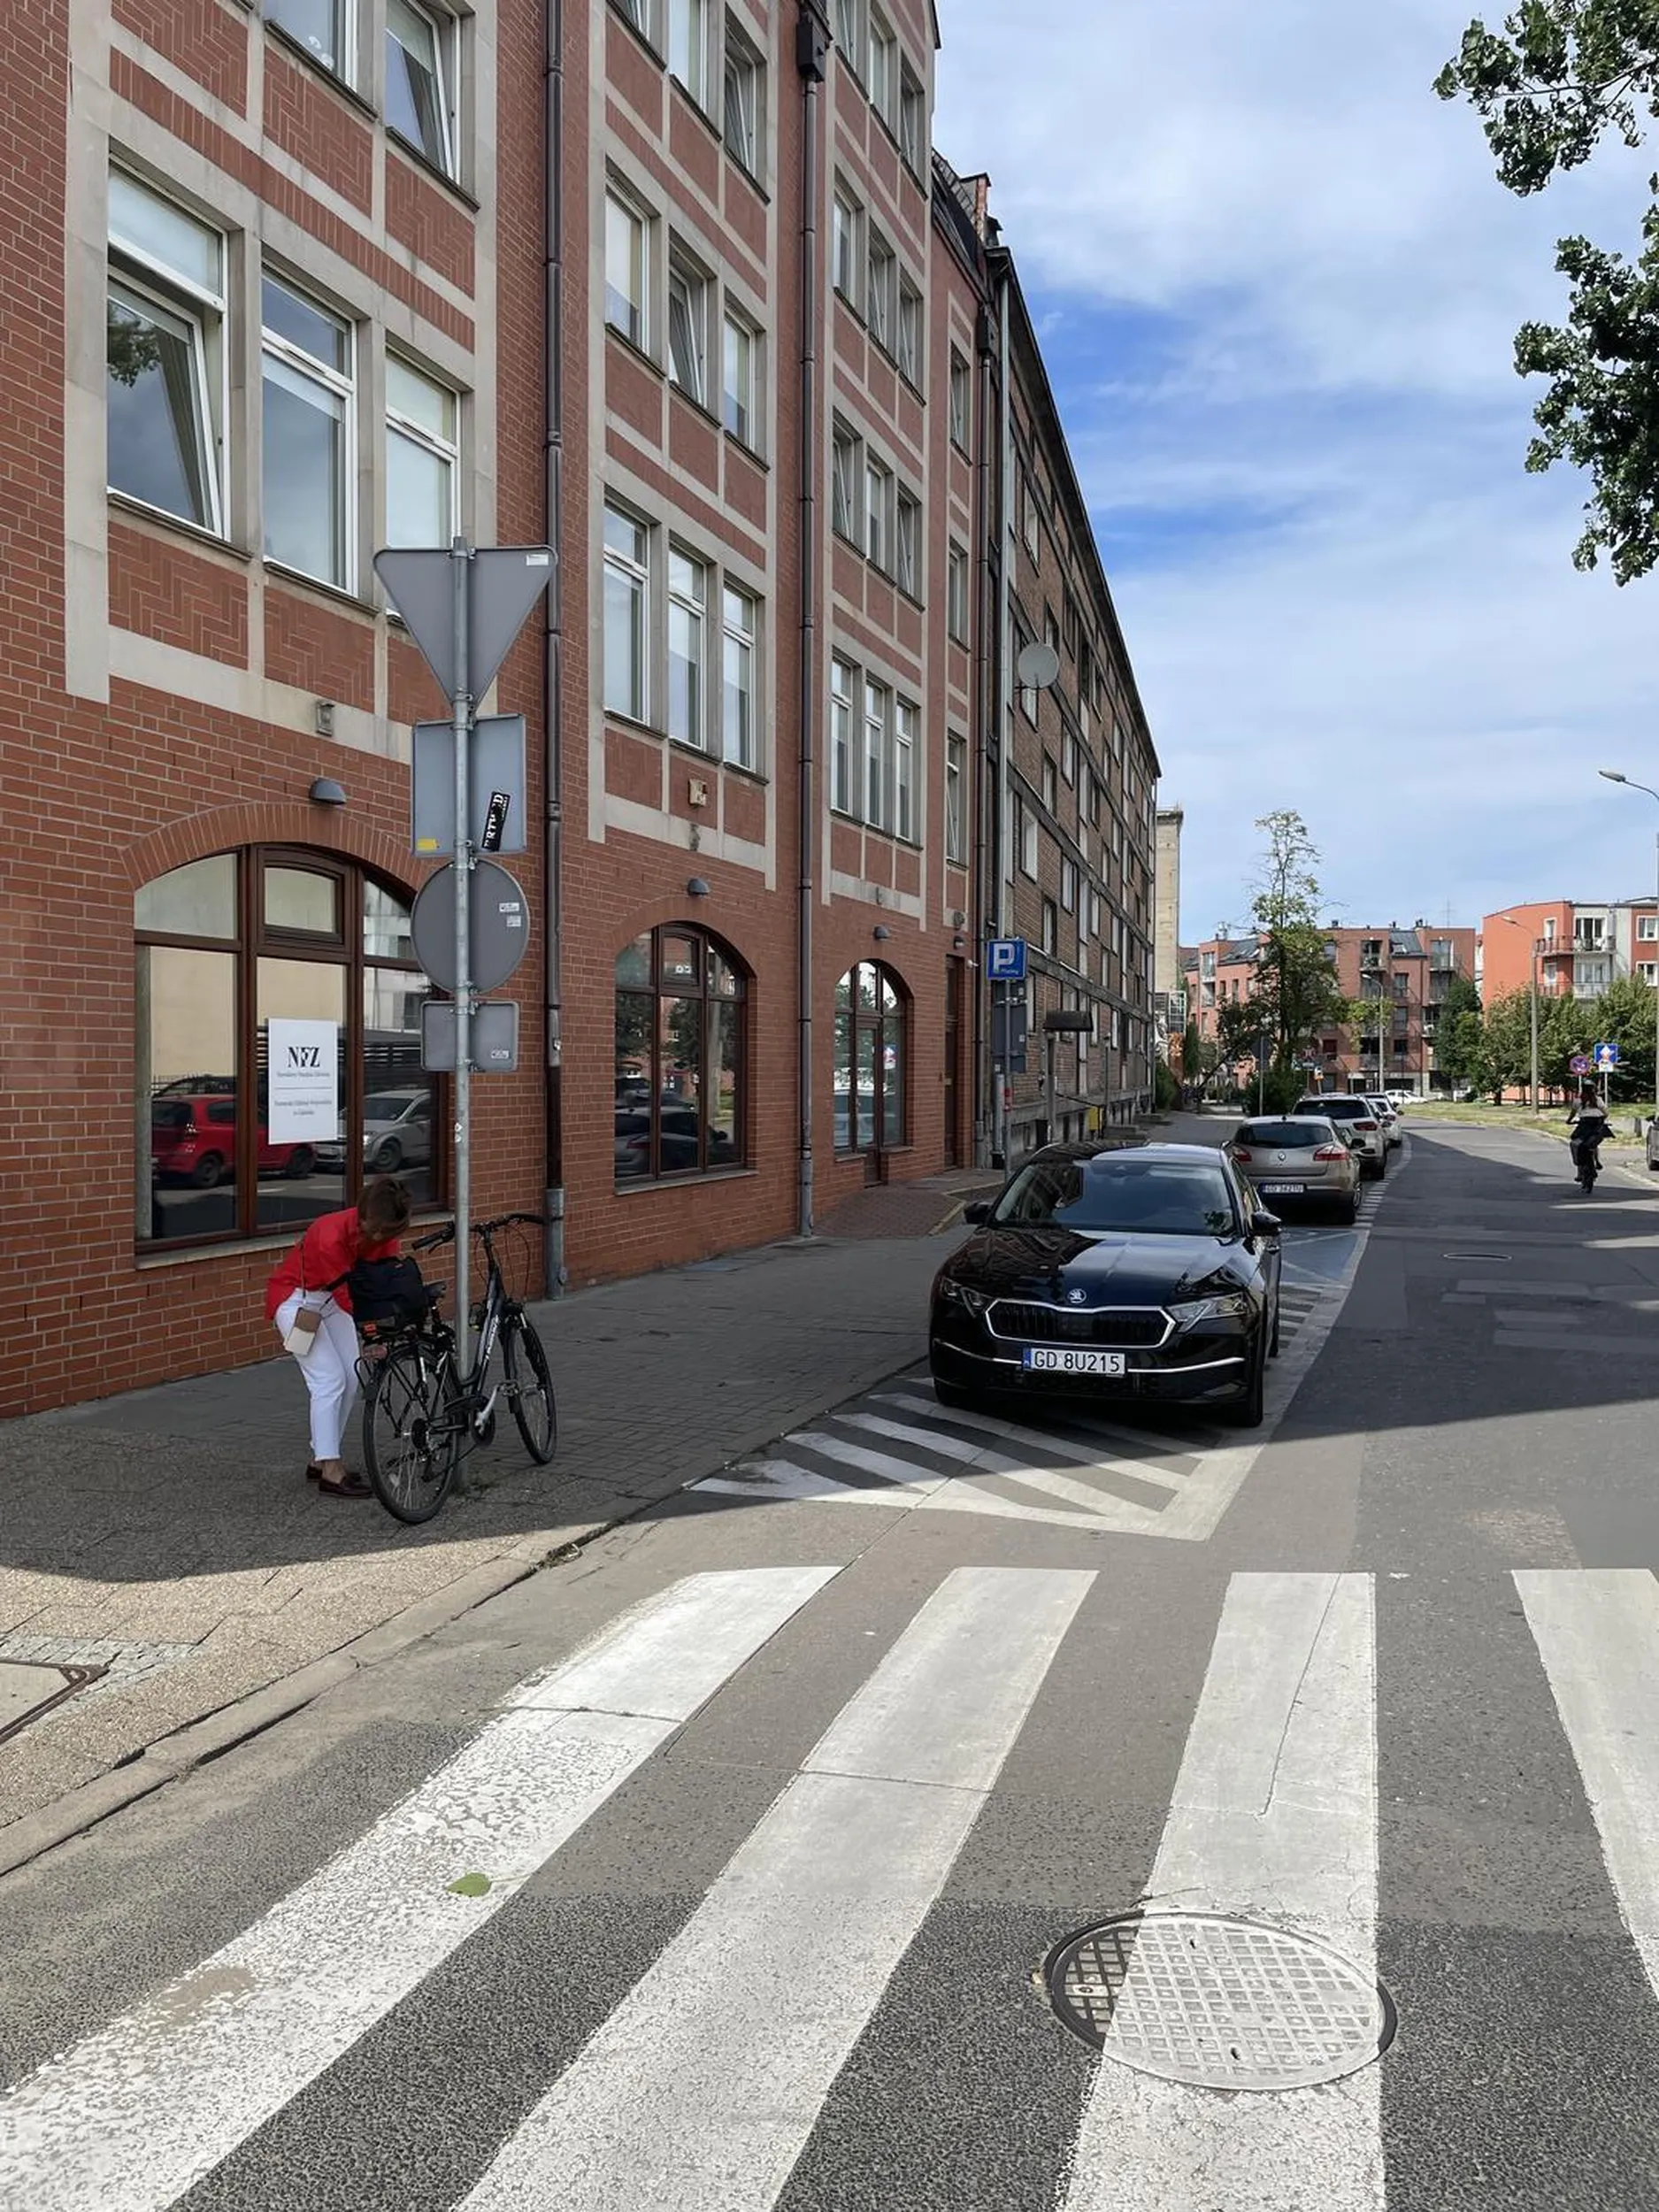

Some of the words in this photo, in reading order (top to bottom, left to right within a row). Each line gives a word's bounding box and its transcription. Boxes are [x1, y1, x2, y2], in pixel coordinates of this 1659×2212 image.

[994, 943, 1015, 973] P
[288, 1047, 320, 1068] NFZ
[1034, 1350, 1057, 1369] GD
[1064, 1353, 1120, 1372] 8U215
